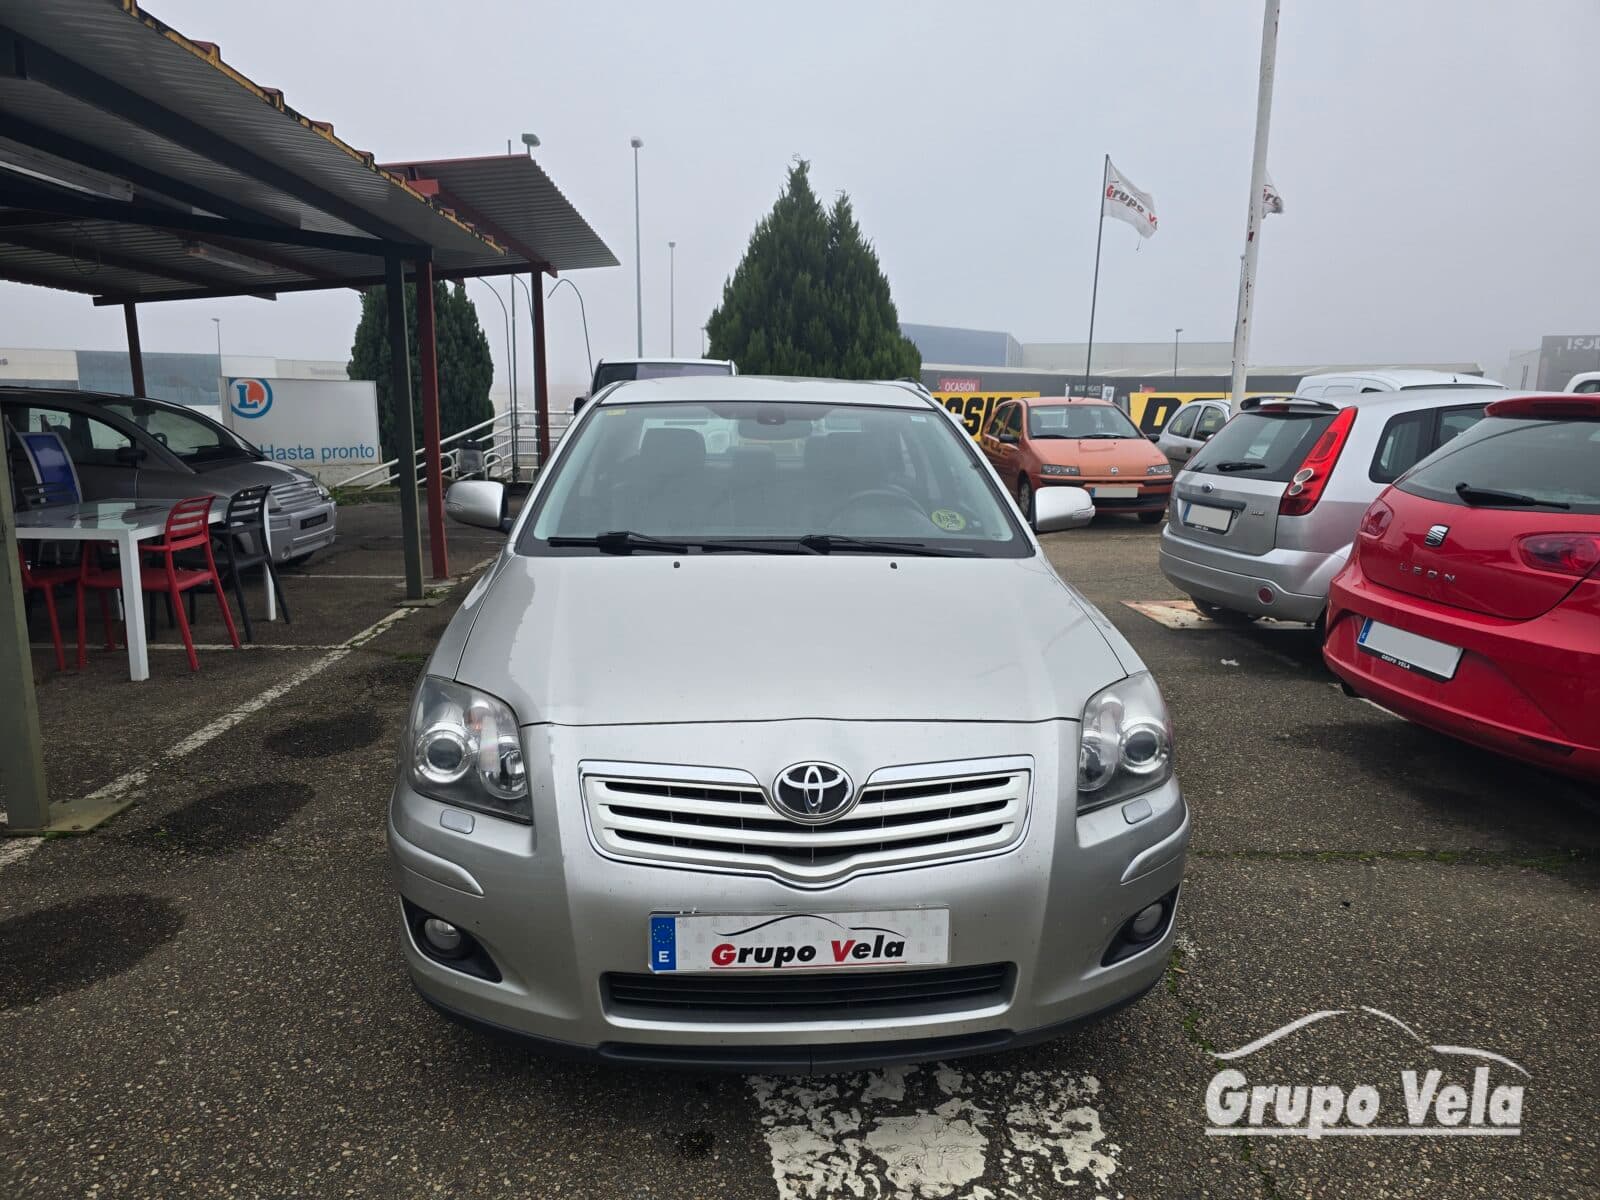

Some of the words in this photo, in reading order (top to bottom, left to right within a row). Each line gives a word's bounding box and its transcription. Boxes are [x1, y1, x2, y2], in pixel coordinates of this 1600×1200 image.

[1106, 184, 1145, 213] Grupo
[944, 381, 976, 392] OCASIÓN
[260, 443, 315, 461] Hasta
[321, 443, 375, 464] pronto
[1399, 562, 1457, 583] LEON
[658, 951, 670, 963] E
[711, 943, 816, 968] Grupo
[831, 935, 905, 962] Vela
